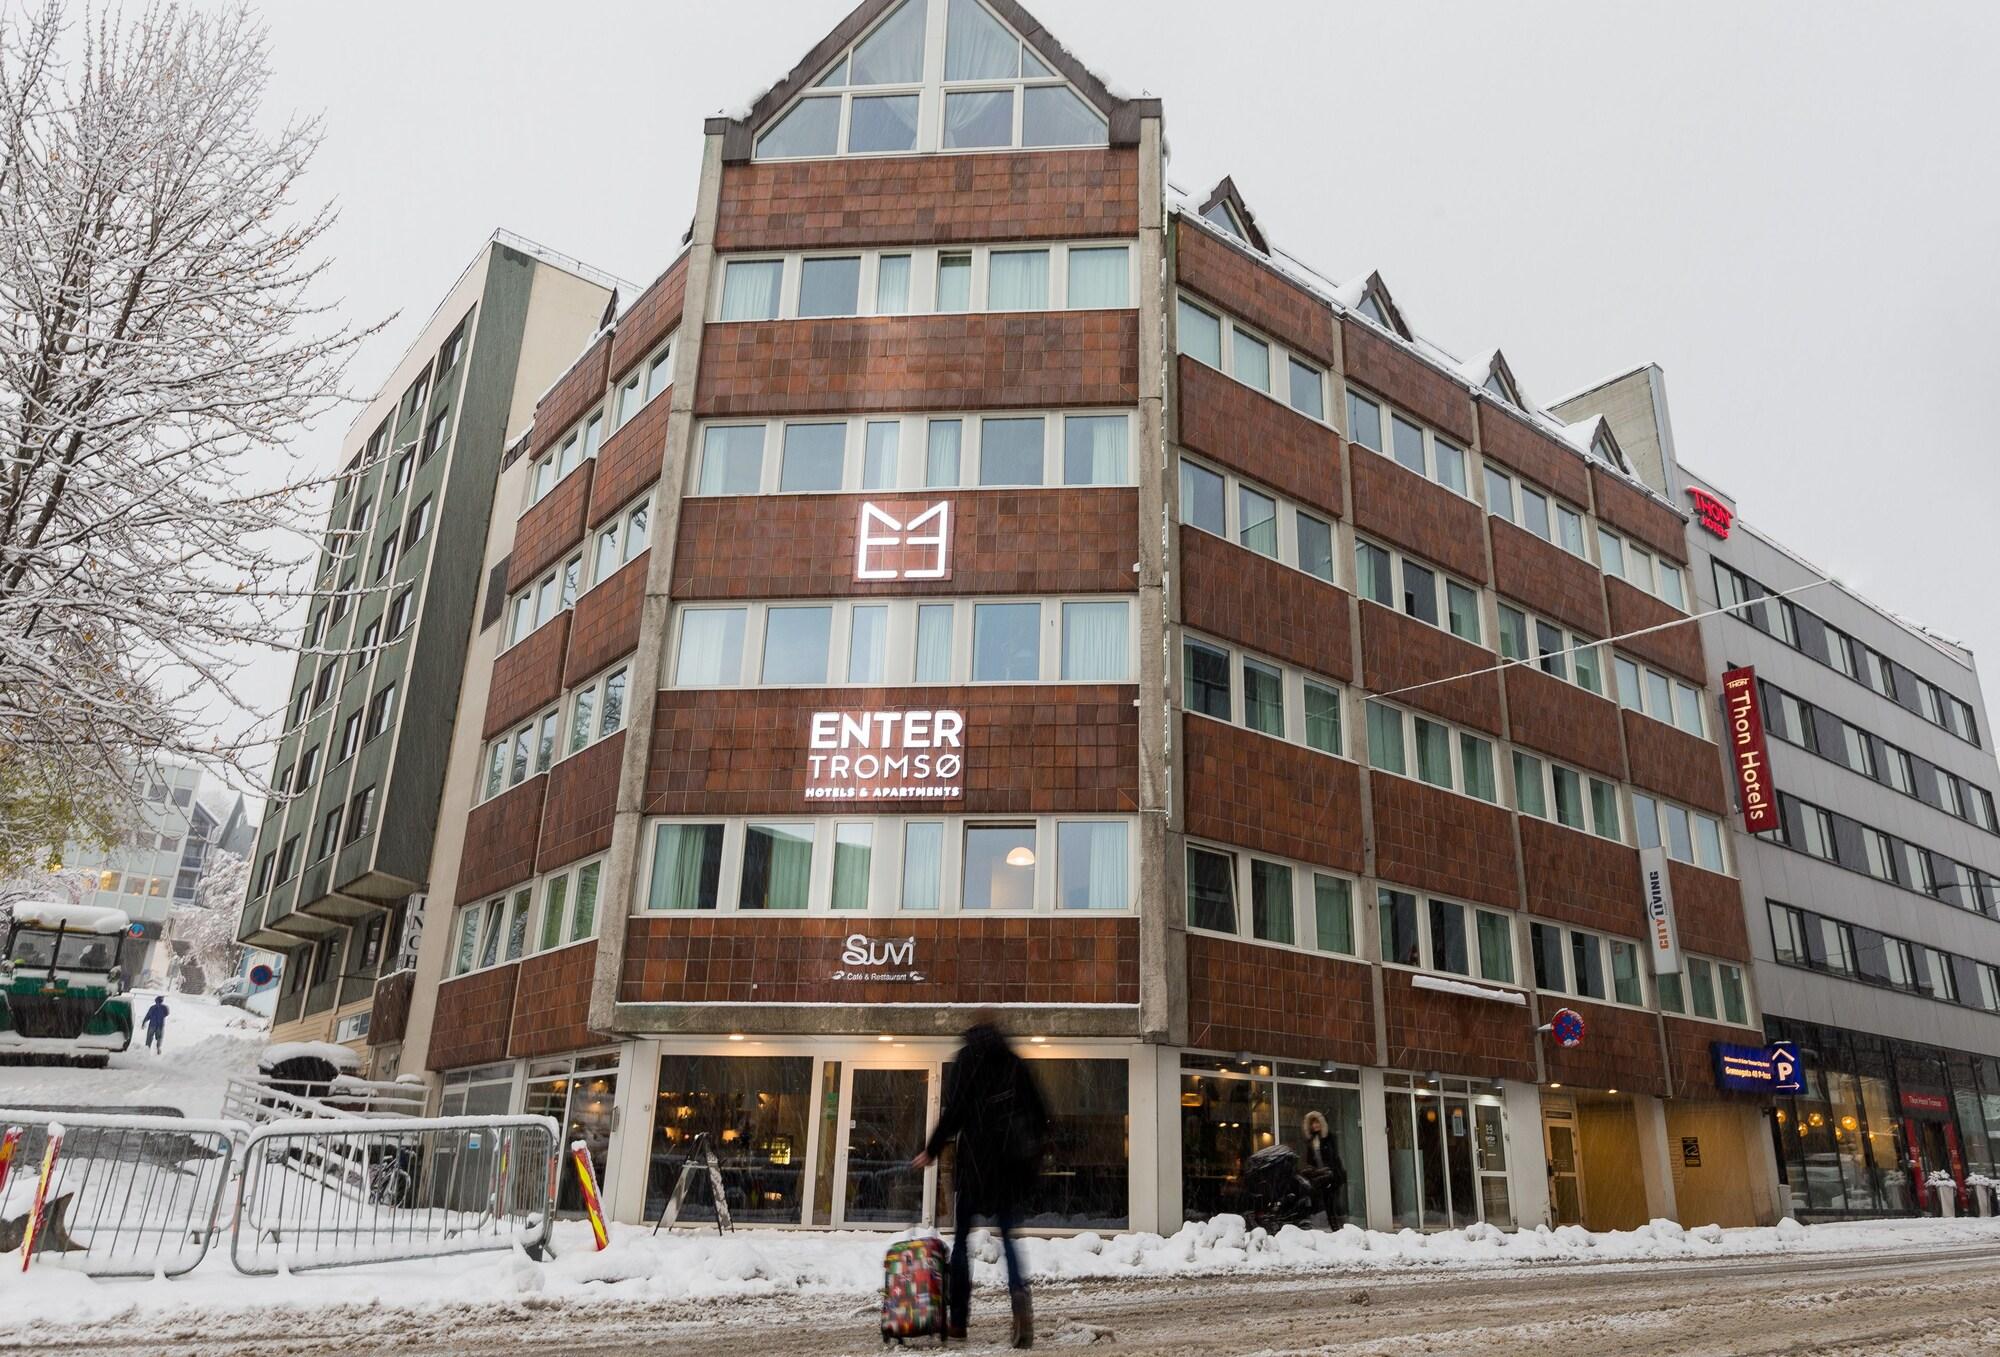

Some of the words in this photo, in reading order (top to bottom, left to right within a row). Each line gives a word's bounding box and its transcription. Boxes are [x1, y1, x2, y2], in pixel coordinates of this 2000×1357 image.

[1685, 485, 1733, 529] THON
[1727, 677, 1750, 689] THON
[810, 709, 964, 749] ENTER
[1731, 689, 1752, 745] Thon
[808, 754, 961, 779] TROMSØ
[805, 787, 856, 798] HOTELS
[859, 787, 868, 797] &
[873, 786, 960, 797] APARTMENTS
[1740, 751, 1768, 820] Hotels
[1649, 870, 1665, 917] LIVING
[842, 934, 915, 966] Suvi
[1655, 918, 1670, 950] CITY
[847, 971, 863, 981] Café
[864, 972, 870, 981] &
[871, 972, 907, 981] Restaurant
[1777, 1062, 1793, 1081] P
